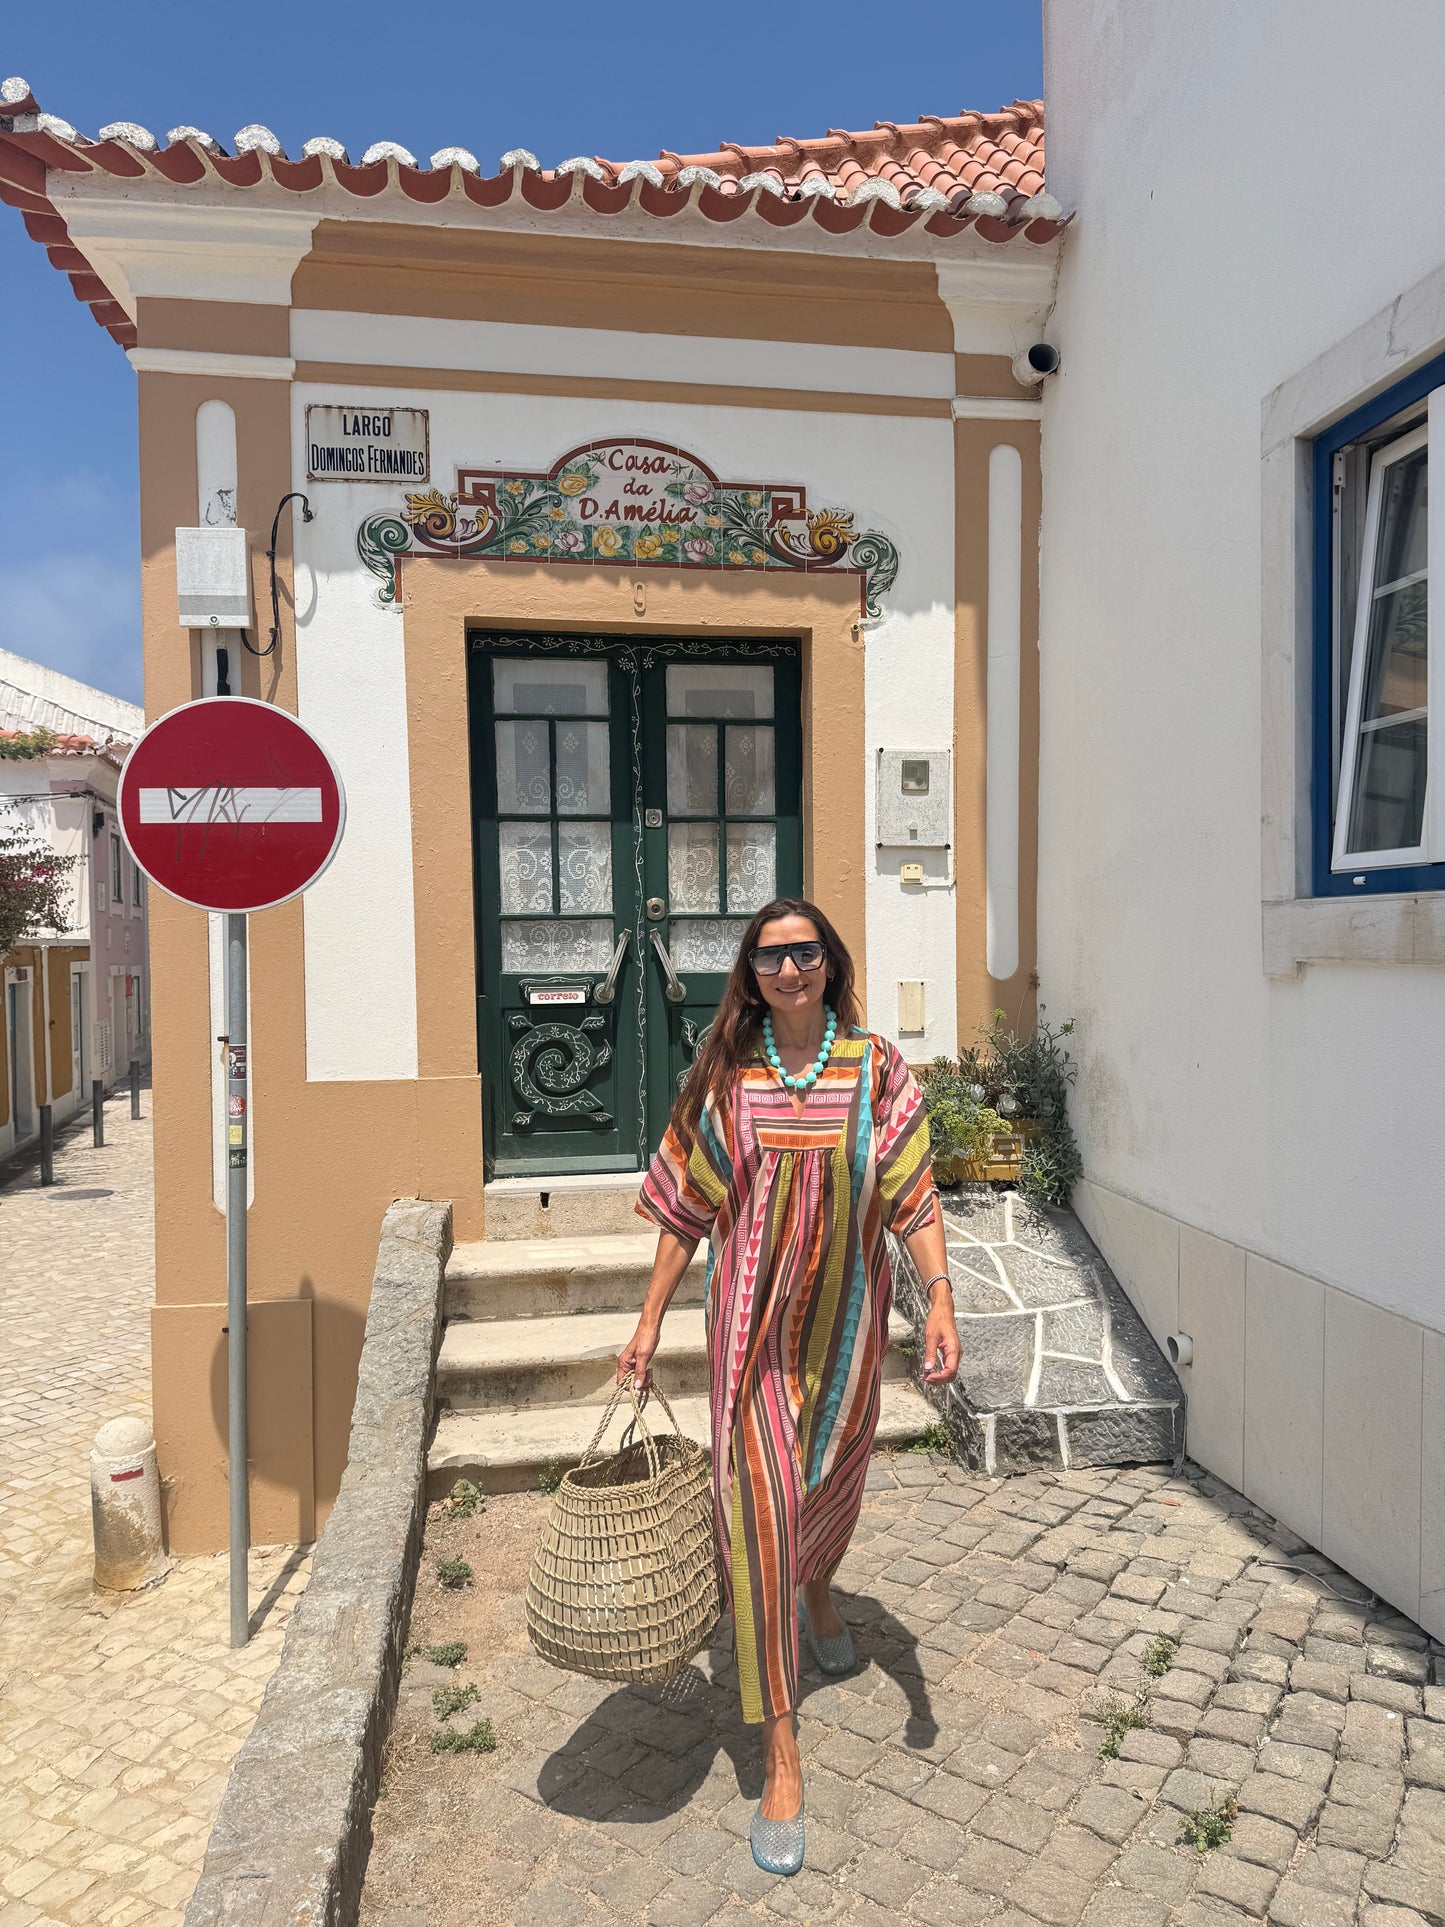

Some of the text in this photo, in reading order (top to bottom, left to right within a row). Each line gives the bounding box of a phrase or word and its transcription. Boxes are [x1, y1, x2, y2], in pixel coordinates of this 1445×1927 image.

[343, 414, 391, 437] LARGO
[311, 444, 425, 476] DOMINGOS FERNANDES
[608, 448, 672, 475] Casa
[623, 477, 654, 496] da
[633, 581, 647, 612] 9
